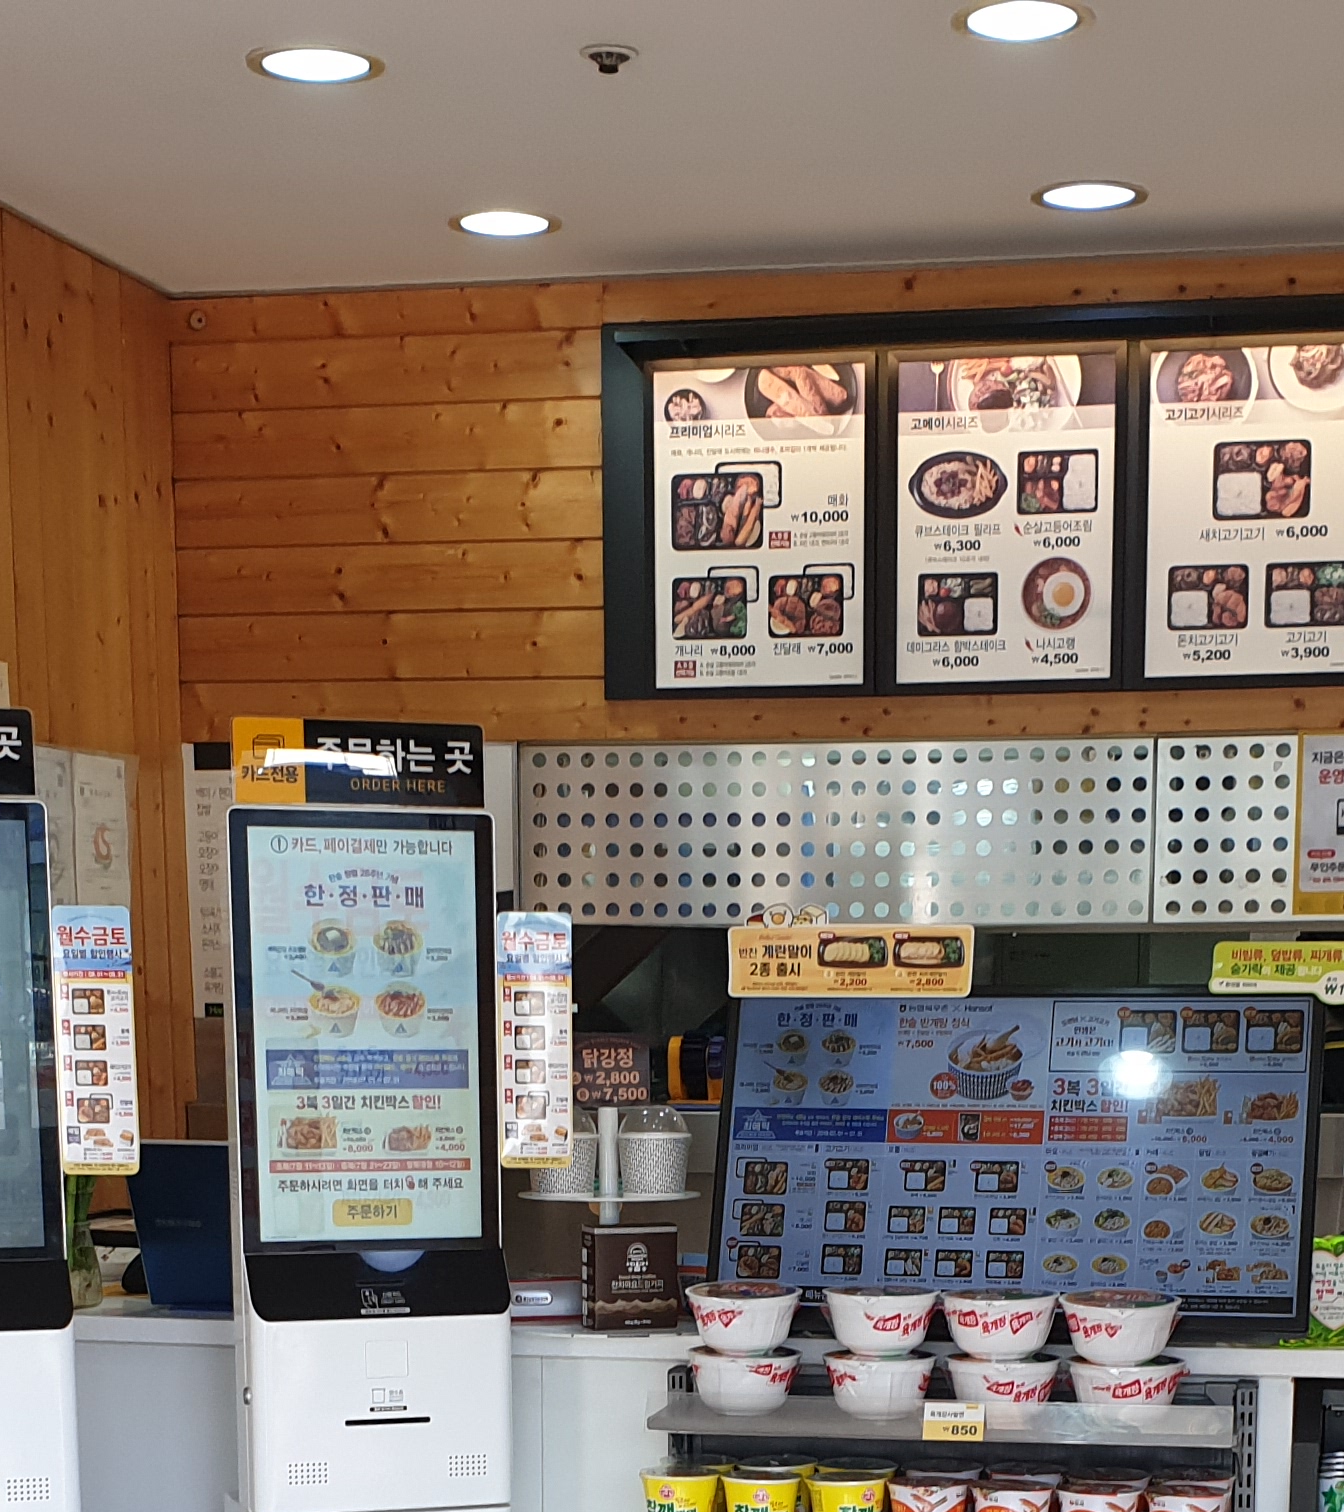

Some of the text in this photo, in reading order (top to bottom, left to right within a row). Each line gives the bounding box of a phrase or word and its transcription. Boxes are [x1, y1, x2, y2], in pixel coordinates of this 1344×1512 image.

[1165, 407, 1243, 421] 고기고기시리즈
[911, 416, 978, 430] 고메이시리즈
[669, 424, 746, 438] 프리미엄시리즈
[790, 510, 848, 524] ₩10,000
[915, 525, 969, 536] 큐브스테이크
[1023, 521, 1092, 534] 순살고등어조림
[1276, 525, 1328, 539] ₩6,000
[934, 539, 981, 552] ₩6,300
[1033, 536, 1080, 549] ₩6,000
[1286, 631, 1327, 643] 고기고기
[674, 644, 756, 657] 개나리 ₩8,000
[773, 642, 853, 655] 진달래 ₩7,000
[907, 639, 1006, 653] 데미그라스 함박스테이크
[1281, 647, 1330, 659] ₩3,900
[932, 655, 979, 668] ₩6,000
[1032, 653, 1078, 666] ₩4,500
[1183, 650, 1231, 662] ₩5,200
[444, 741, 473, 774] 곳
[1312, 751, 1344, 764] 지금은
[351, 778, 446, 793] ORDER HERE
[291, 838, 452, 855] 카드, 가능합니다
[57, 925, 127, 947] 월수금토
[501, 931, 567, 951] 월수금토
[63, 949, 122, 959] 요일별 할인행사
[762, 945, 812, 959] 계란말이
[750, 964, 801, 977] 2종 출시
[582, 1049, 634, 1068] 닭강정
[584, 1072, 639, 1085] ₩2,800
[1053, 1078, 1080, 1096] 3복
[297, 1095, 441, 1109] 3복 3일간 치킨박스 할인!
[592, 1088, 647, 1102] ₩7,500
[1051, 1099, 1097, 1113] 치킨박스
[278, 1178, 464, 1191] 주문하시려면 화면을 터치 해 주세요
[347, 1205, 398, 1219] 주문하기
[943, 1425, 977, 1435] ₩850
